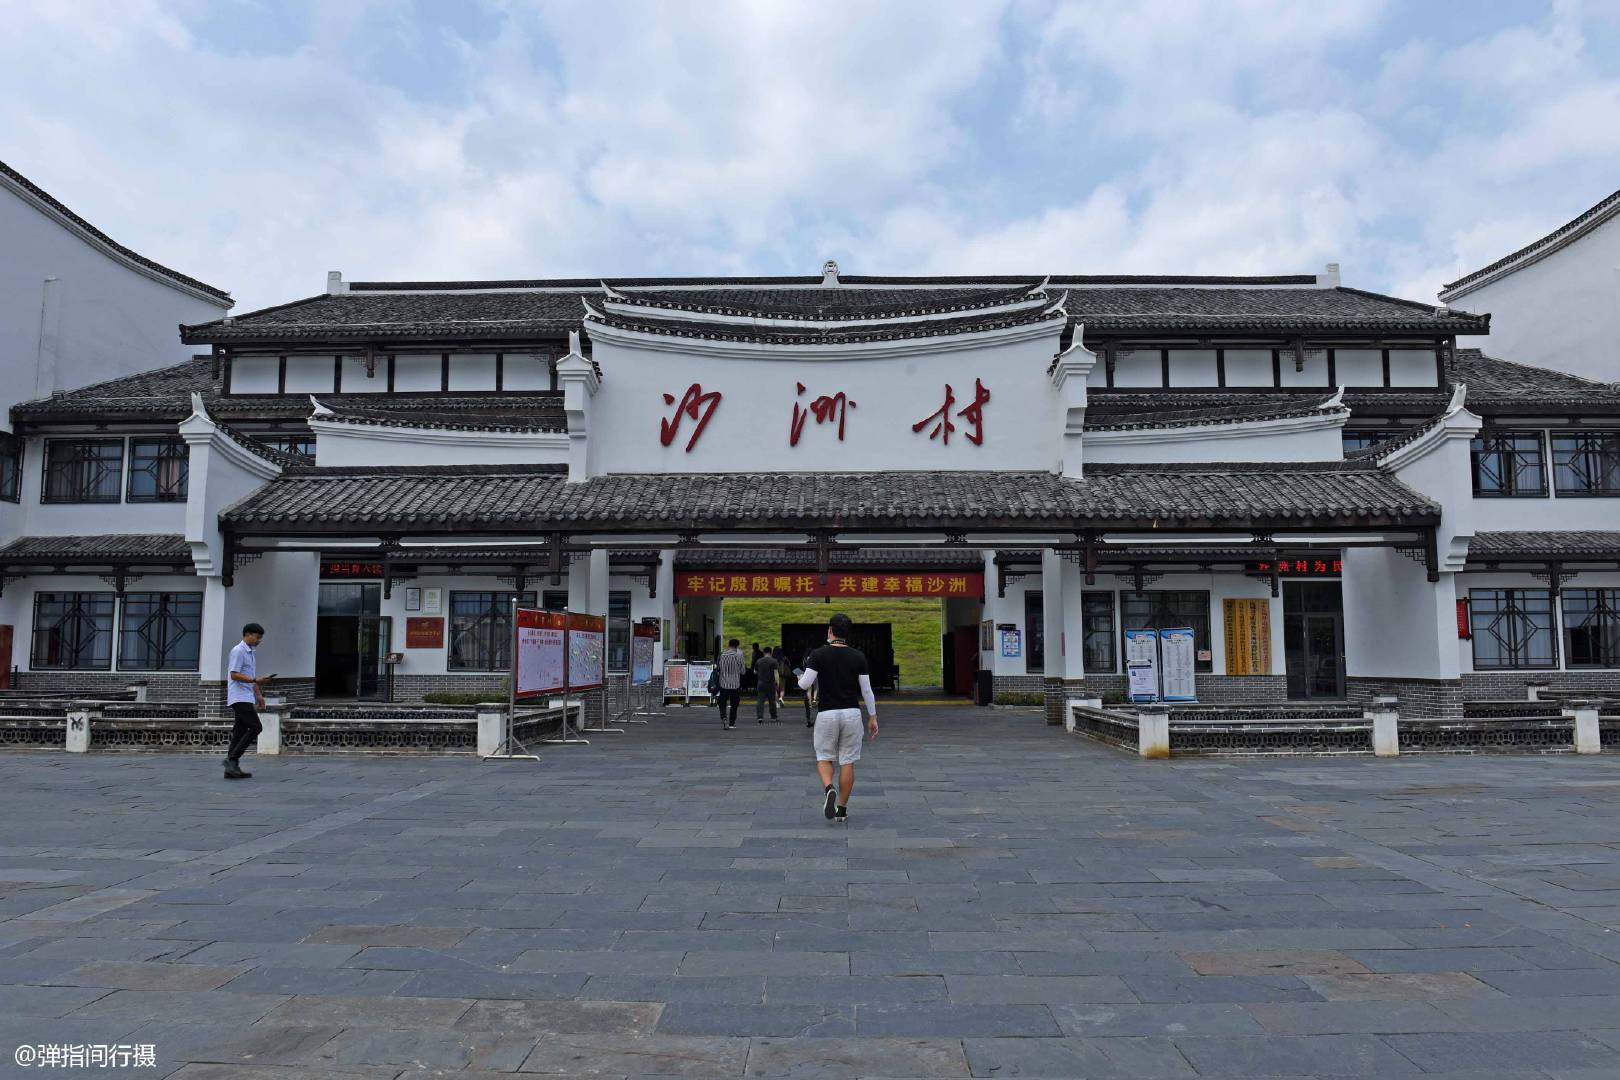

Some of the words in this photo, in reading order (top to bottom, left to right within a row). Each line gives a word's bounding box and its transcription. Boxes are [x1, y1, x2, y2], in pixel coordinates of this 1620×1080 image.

[661, 378, 990, 453] 沙洲村
[687, 575, 814, 593] 牢记殷殷嘱托
[839, 575, 967, 593] 共建幸福沙洲
